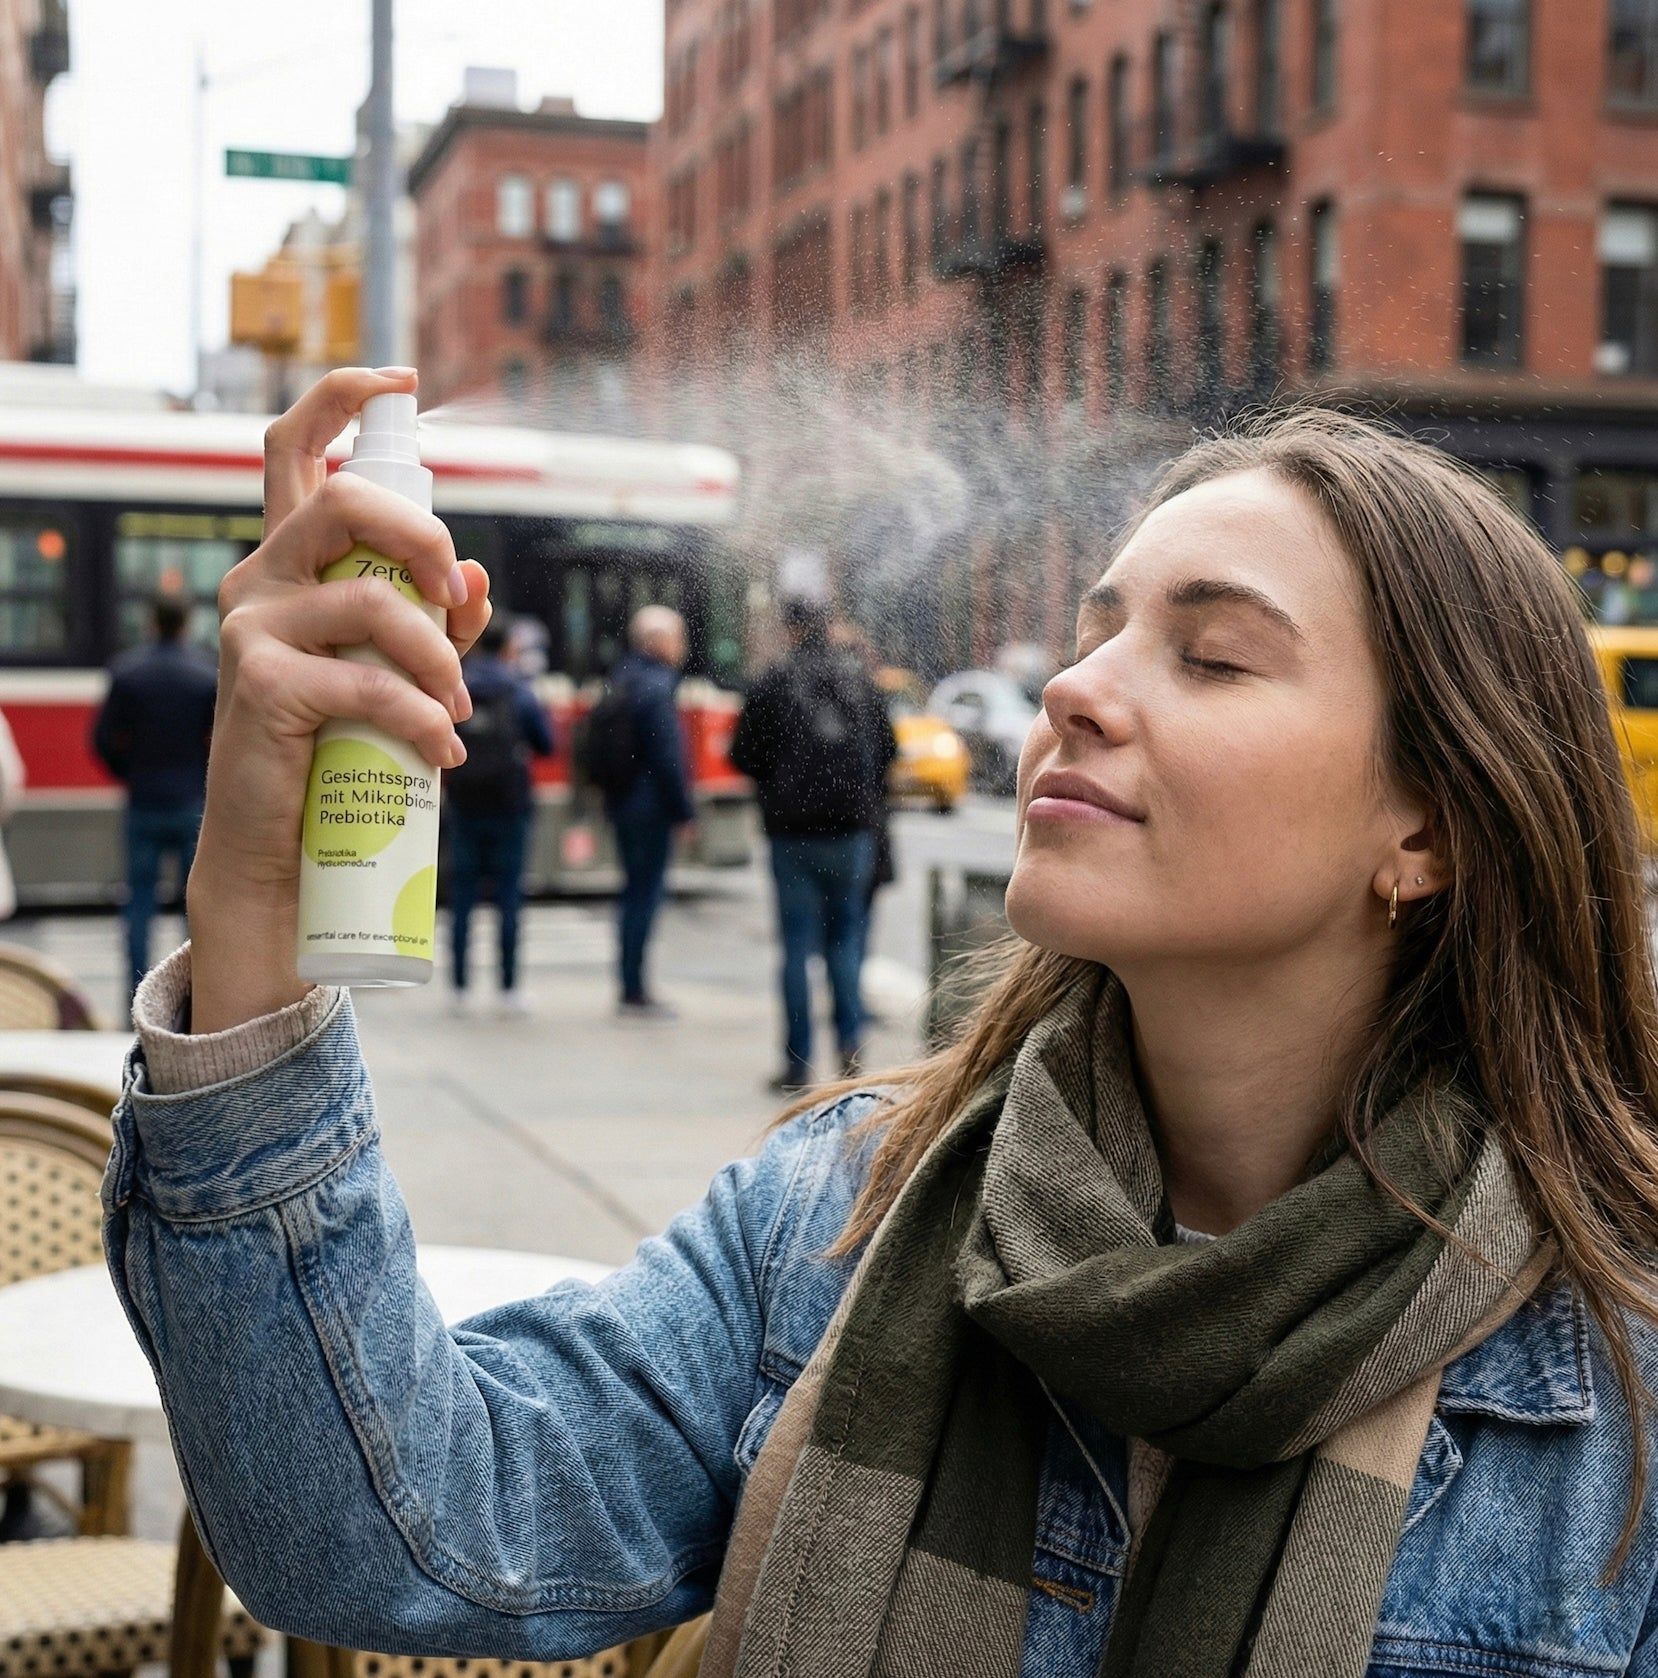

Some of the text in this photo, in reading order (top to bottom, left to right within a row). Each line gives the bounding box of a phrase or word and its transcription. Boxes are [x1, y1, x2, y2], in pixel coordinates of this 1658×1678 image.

[355, 560, 413, 584] Zero
[321, 769, 431, 793] Gesichtsspray
[320, 790, 344, 804] mit
[320, 810, 405, 826] Prebiotika
[337, 932, 356, 941] care
[358, 931, 371, 941] for
